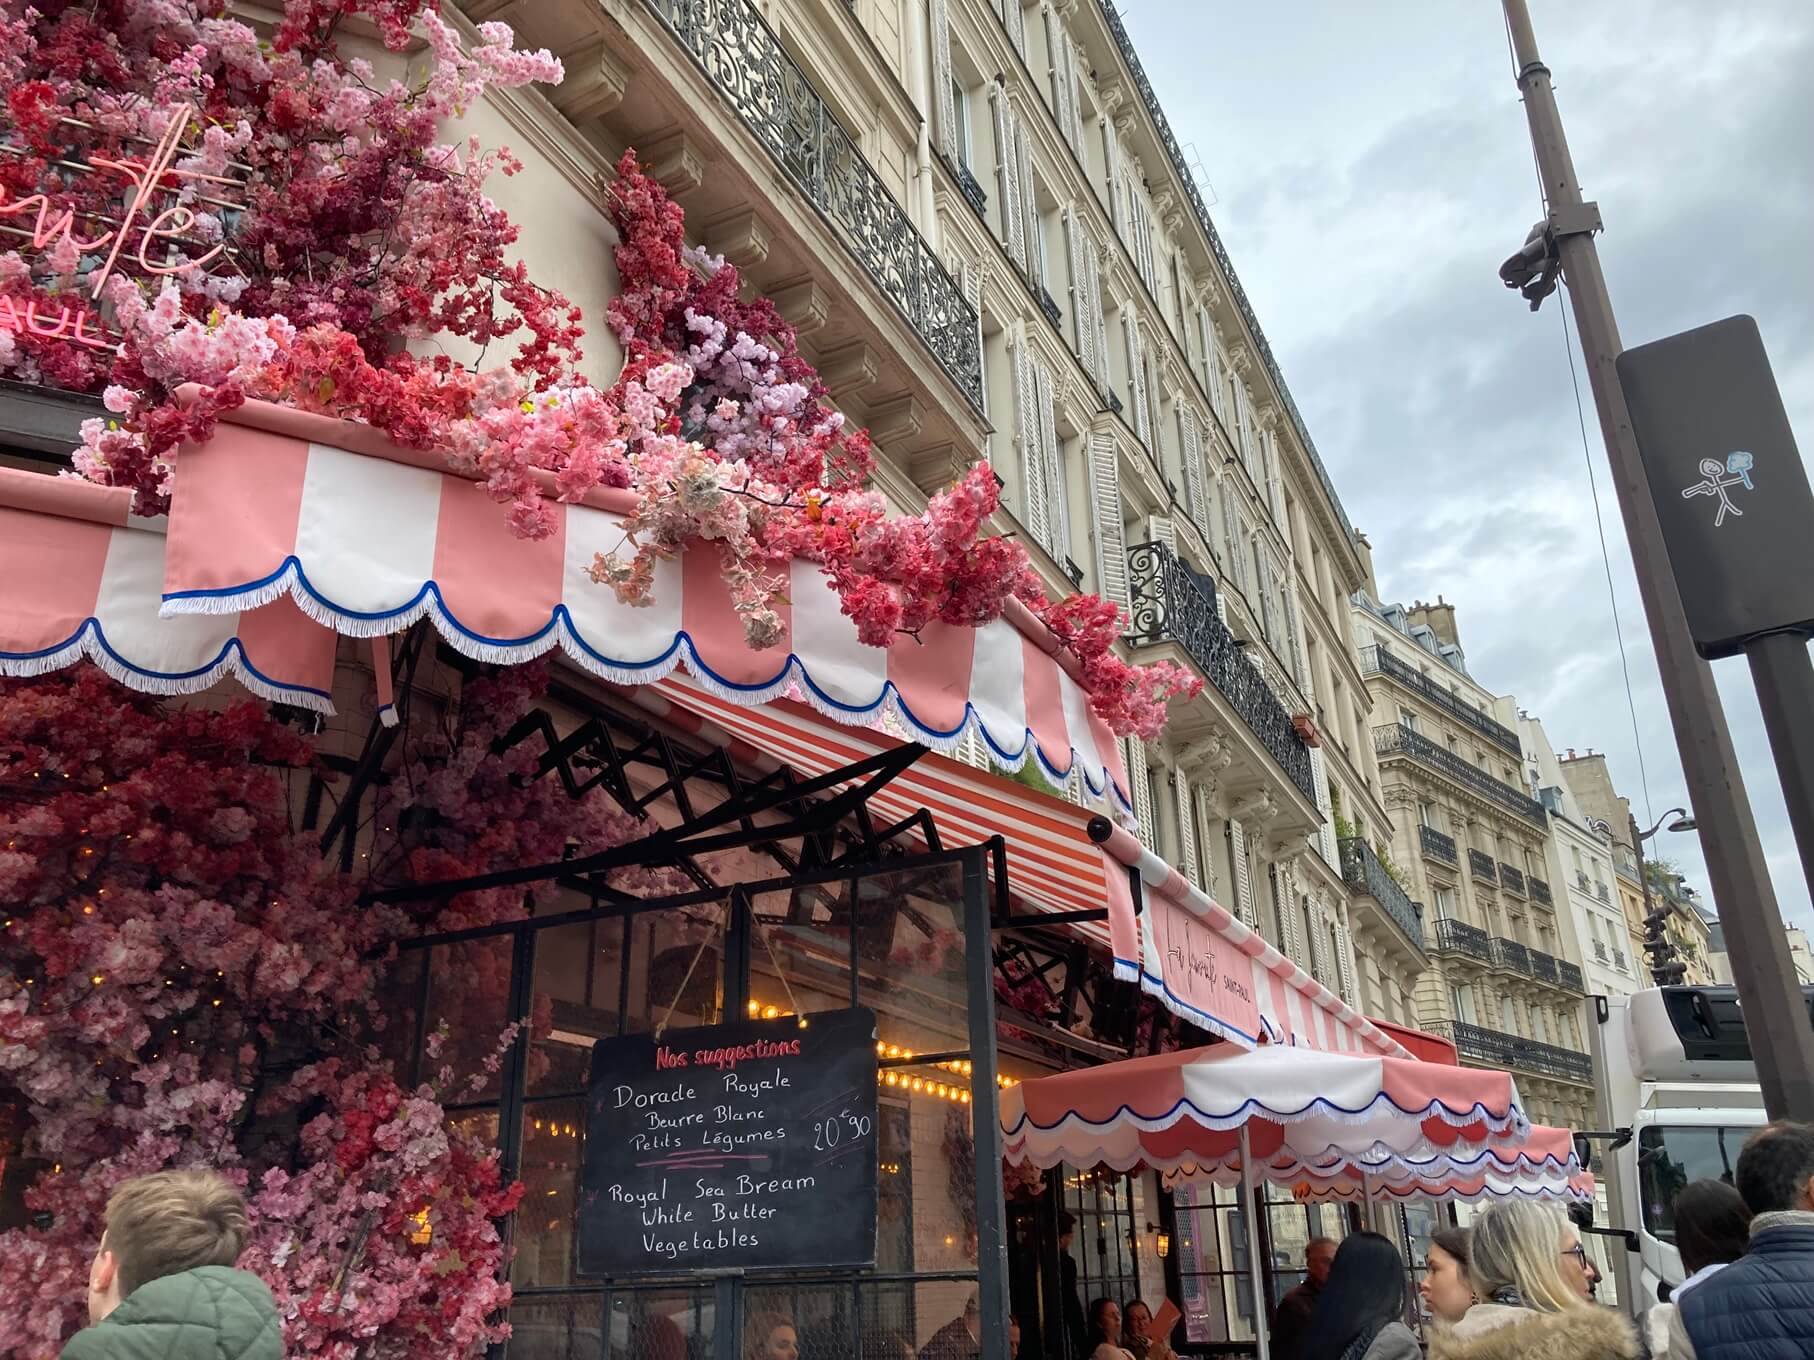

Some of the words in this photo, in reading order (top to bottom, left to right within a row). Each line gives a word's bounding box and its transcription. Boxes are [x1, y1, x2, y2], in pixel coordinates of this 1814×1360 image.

[655, 1047, 688, 1070] Nos
[694, 1039, 801, 1069] suggestions
[613, 1084, 697, 1109] Dorade
[723, 1067, 791, 1098] Royale
[645, 1112, 704, 1130] Beurre
[713, 1105, 765, 1123] Blanc
[629, 1134, 681, 1151] Petits
[702, 1127, 786, 1153] Légumes
[608, 1178, 667, 1209] Royal
[695, 1178, 725, 1199] Sea
[735, 1175, 815, 1196] Bream
[642, 1204, 694, 1226] White
[711, 1202, 777, 1222] Butter
[643, 1228, 759, 1259] Vegetables
